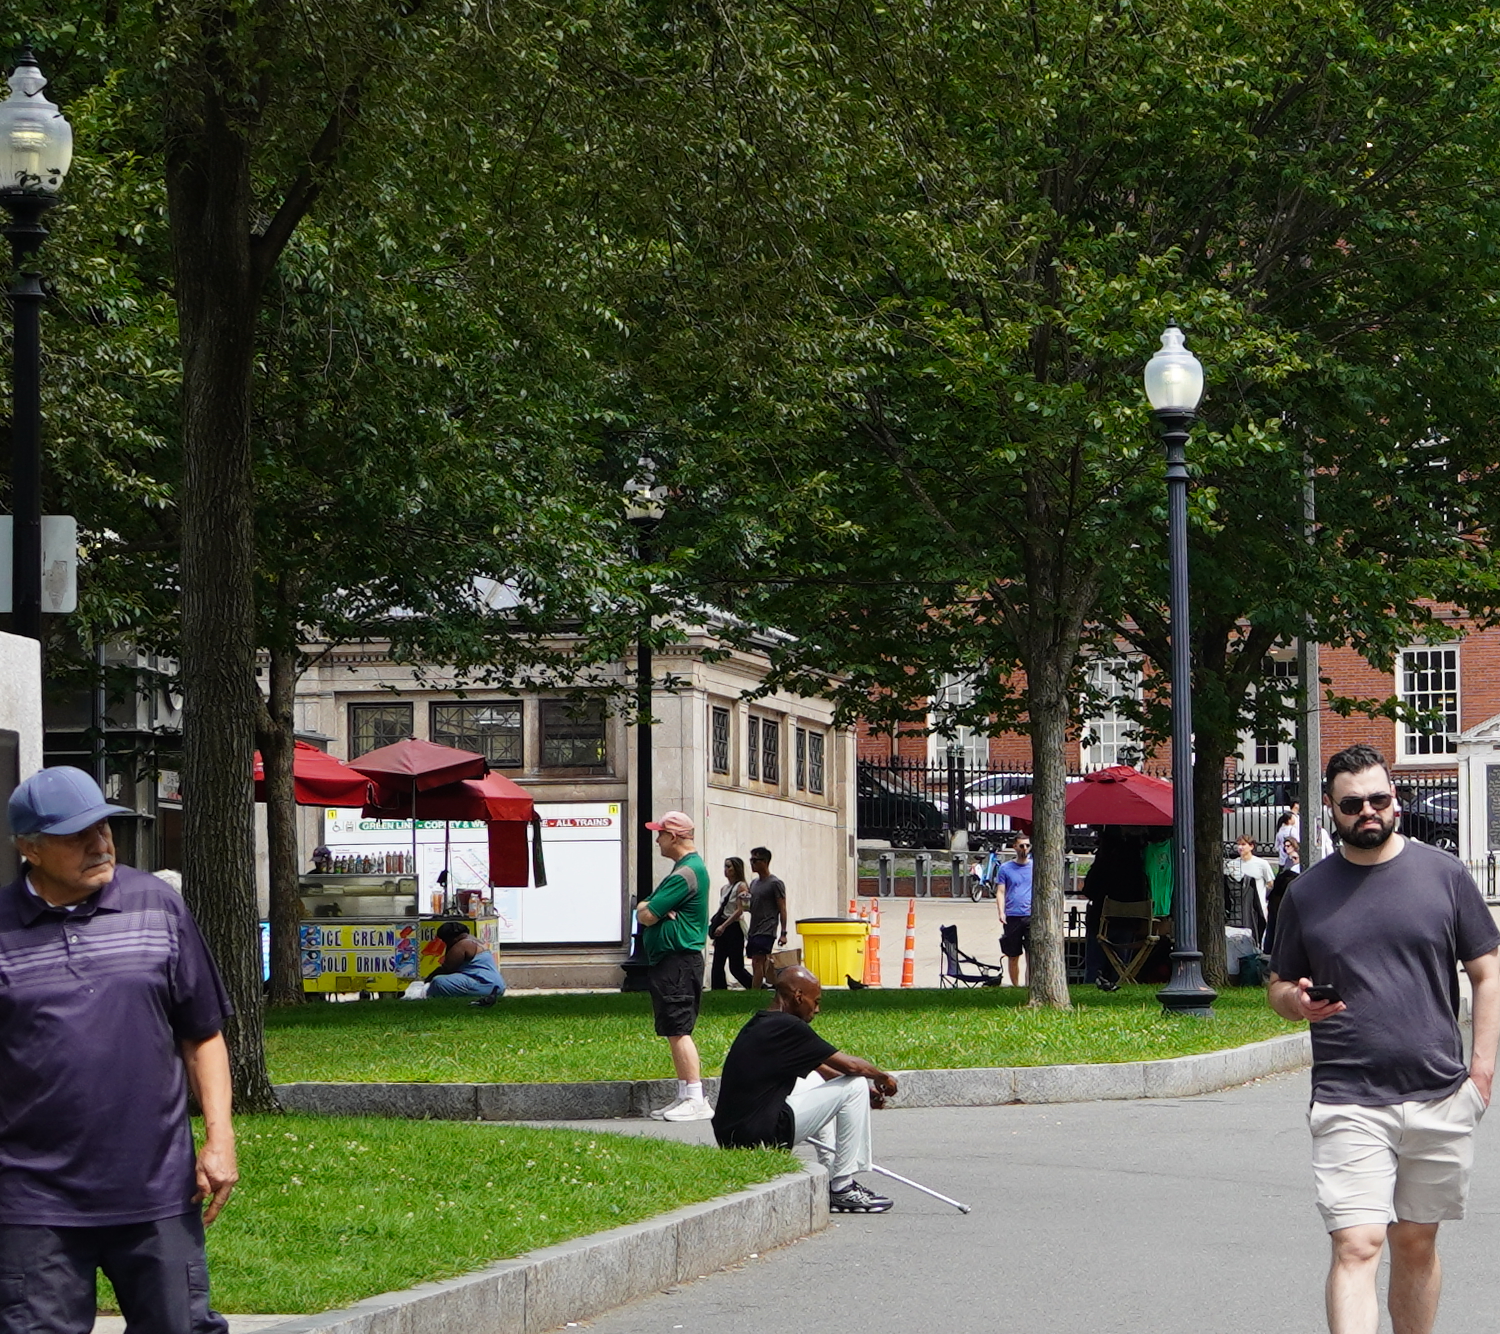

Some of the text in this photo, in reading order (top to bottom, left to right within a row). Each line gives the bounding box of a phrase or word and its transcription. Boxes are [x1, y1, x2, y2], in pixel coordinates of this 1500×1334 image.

[362, 821, 396, 830] GREEN
[396, 821, 413, 829] LIN
[424, 820, 462, 829] COPEY
[556, 819, 575, 828] ALL
[575, 818, 609, 827] TRAINS
[321, 930, 396, 947] ICE CREAM
[320, 956, 396, 973] COLD DRINKS
